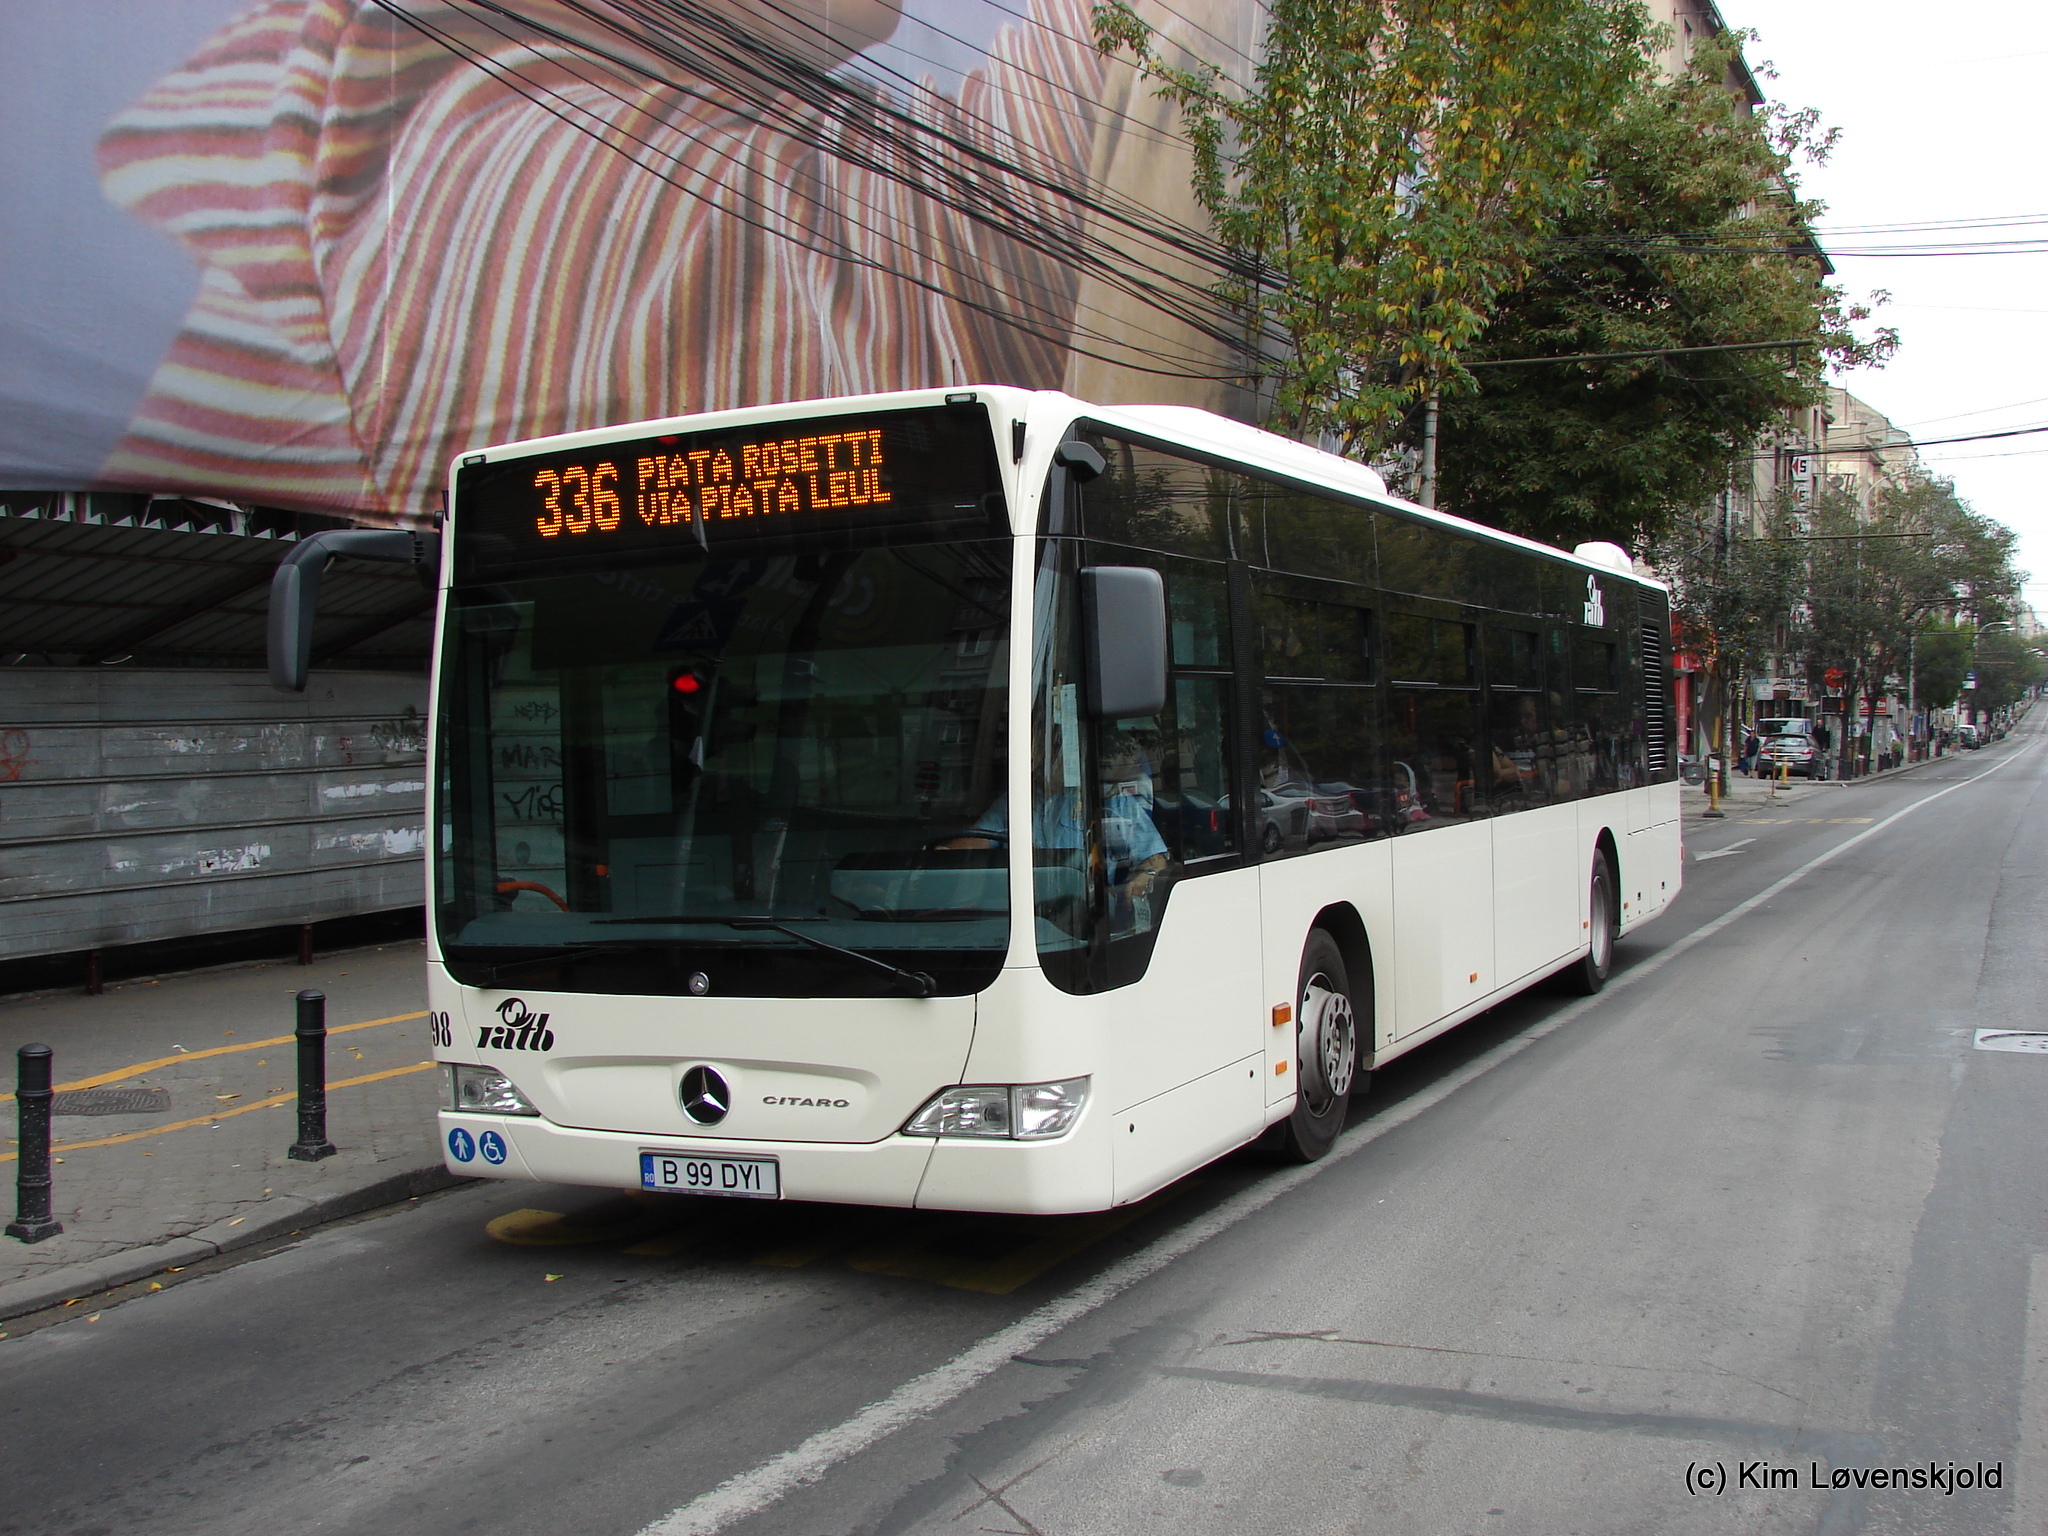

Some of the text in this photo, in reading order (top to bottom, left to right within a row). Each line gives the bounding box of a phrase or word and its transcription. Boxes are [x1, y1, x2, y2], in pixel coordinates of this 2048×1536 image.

[637, 429, 883, 491] PIATA ROSETTI
[534, 461, 621, 537] 336
[637, 467, 893, 526] VIA PIATA LEUL
[762, 1095, 851, 1109] CITARO
[662, 1159, 679, 1185] B
[686, 1161, 713, 1187] 99
[721, 1163, 761, 1190] DYI
